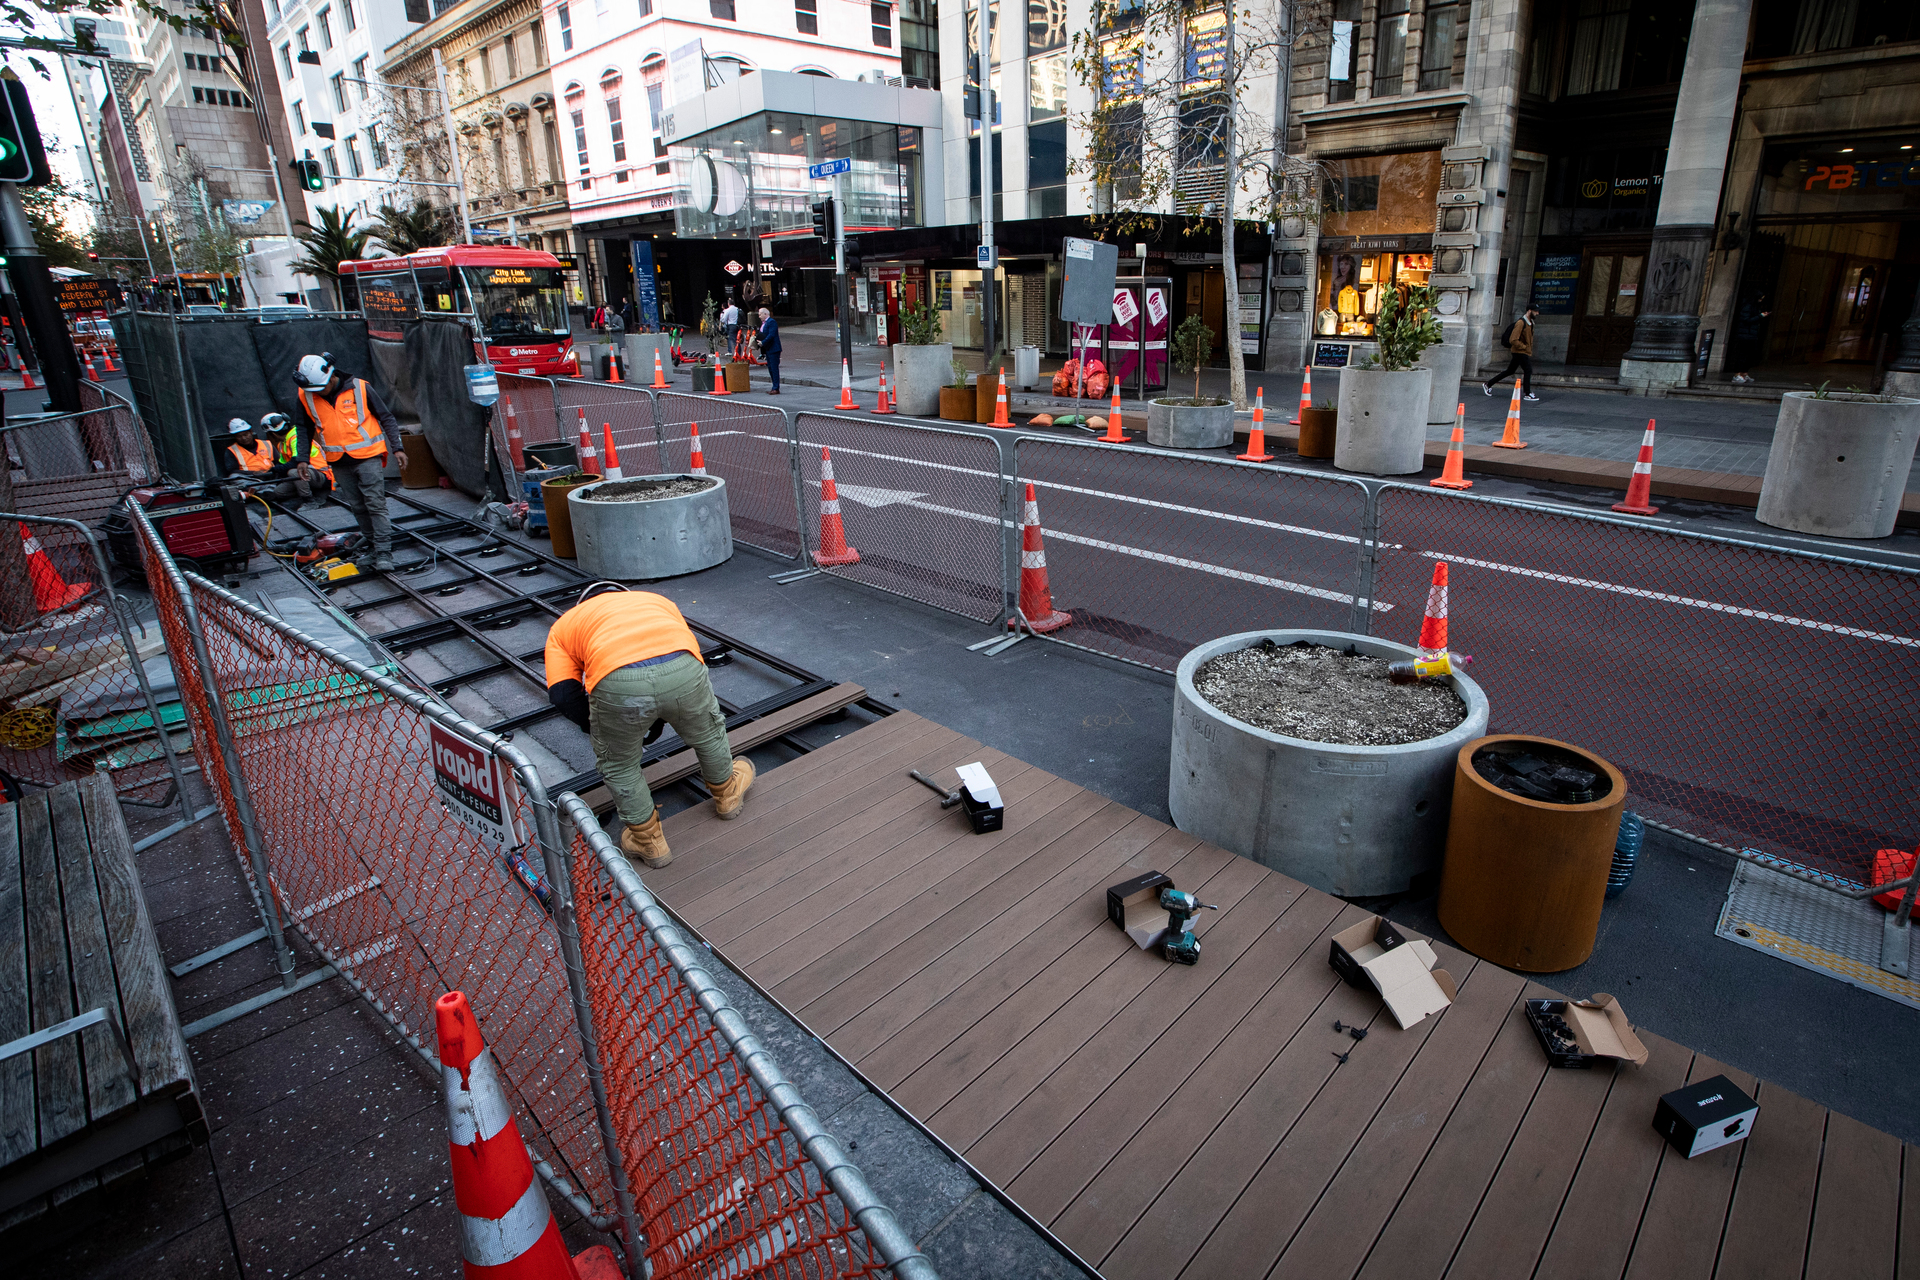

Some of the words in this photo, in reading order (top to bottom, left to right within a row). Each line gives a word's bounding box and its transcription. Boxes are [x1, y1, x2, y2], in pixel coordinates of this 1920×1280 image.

[660, 113, 676, 138] 115
[820, 162, 835, 175] QUEEN
[1614, 178, 1648, 187] Lemon
[1614, 188, 1646, 196] Organics
[224, 202, 265, 220] SAP
[1350, 241, 1366, 249] GREAT
[1368, 240, 1381, 248] KIWI
[1383, 240, 1399, 248] YARNS
[64, 282, 99, 291] BETWEEN
[61, 292, 94, 300] FEDERAL
[60, 301, 76, 309] AND
[435, 740, 494, 798] rapid
[438, 774, 498, 820] RENT-A-FENCE
[442, 794, 461, 817] 0800
[464, 810, 474, 825] 89
[477, 820, 488, 834] 49
[492, 828, 505, 842] 29
